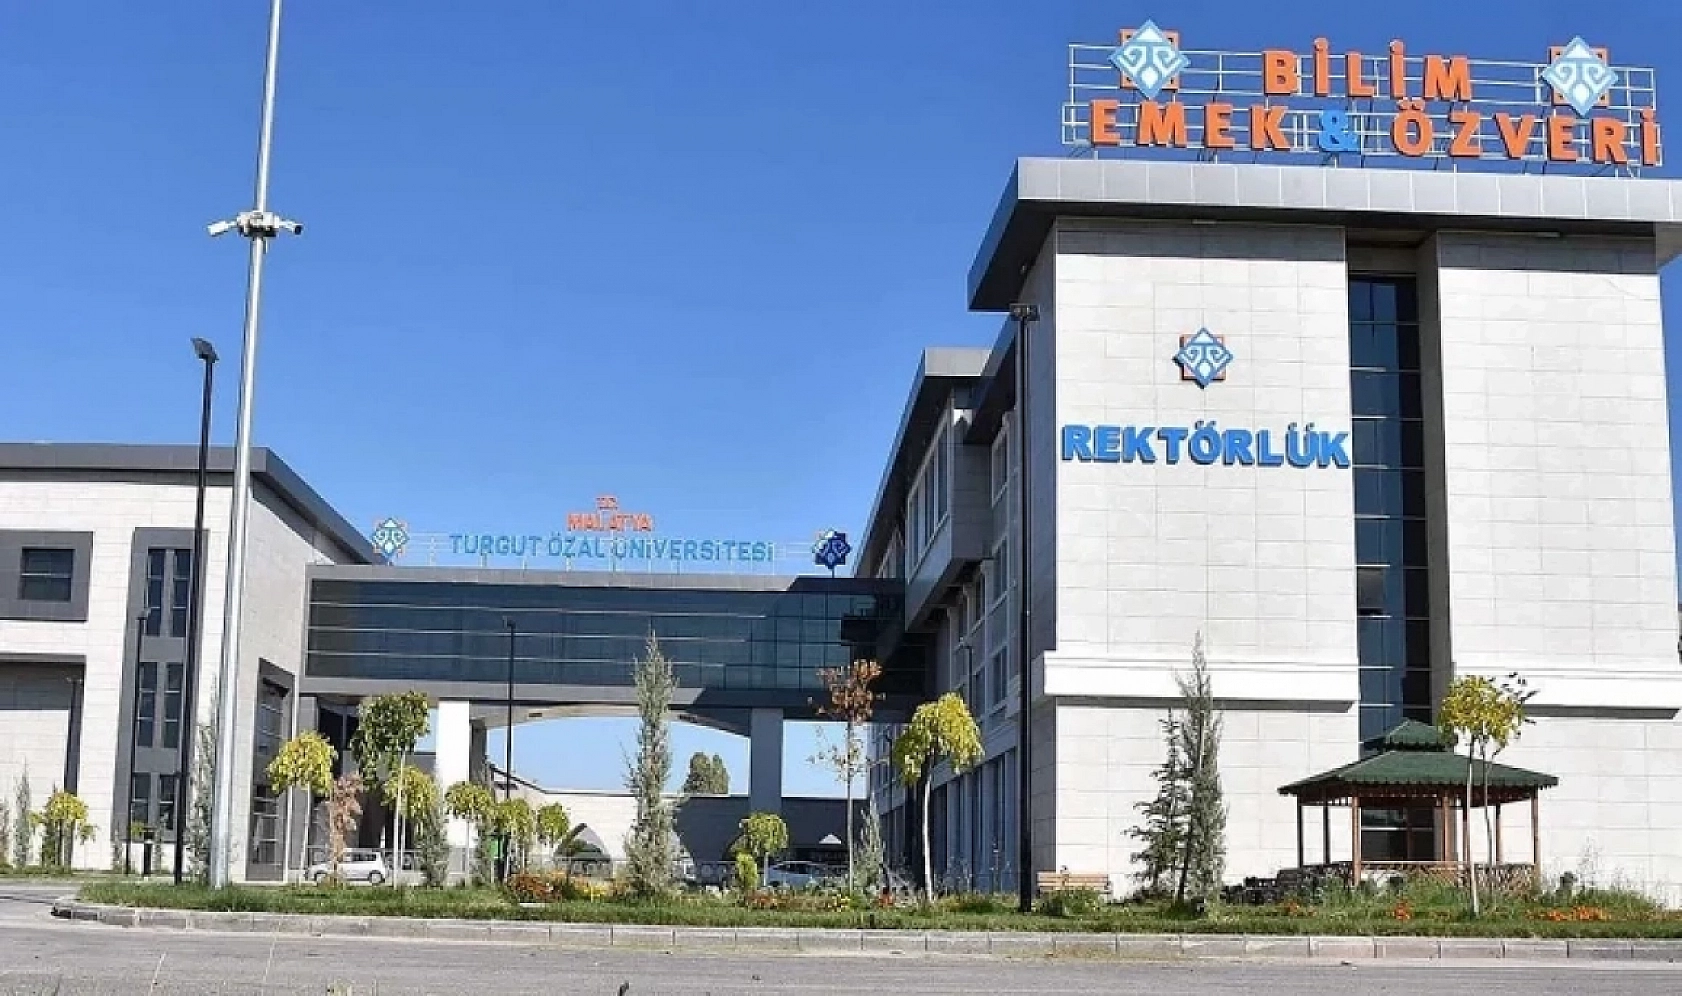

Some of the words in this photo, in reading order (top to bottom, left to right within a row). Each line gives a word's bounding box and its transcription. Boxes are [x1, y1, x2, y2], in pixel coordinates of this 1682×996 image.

[1262, 38, 1471, 101] BİLİM
[1089, 100, 1291, 150] EMEK
[1318, 109, 1361, 153] &
[1391, 99, 1661, 166] ÖZVERİ
[1061, 420, 1350, 469] REKTÖRLÜK
[449, 534, 542, 557] TURGUT
[547, 533, 605, 558] ÖZAL
